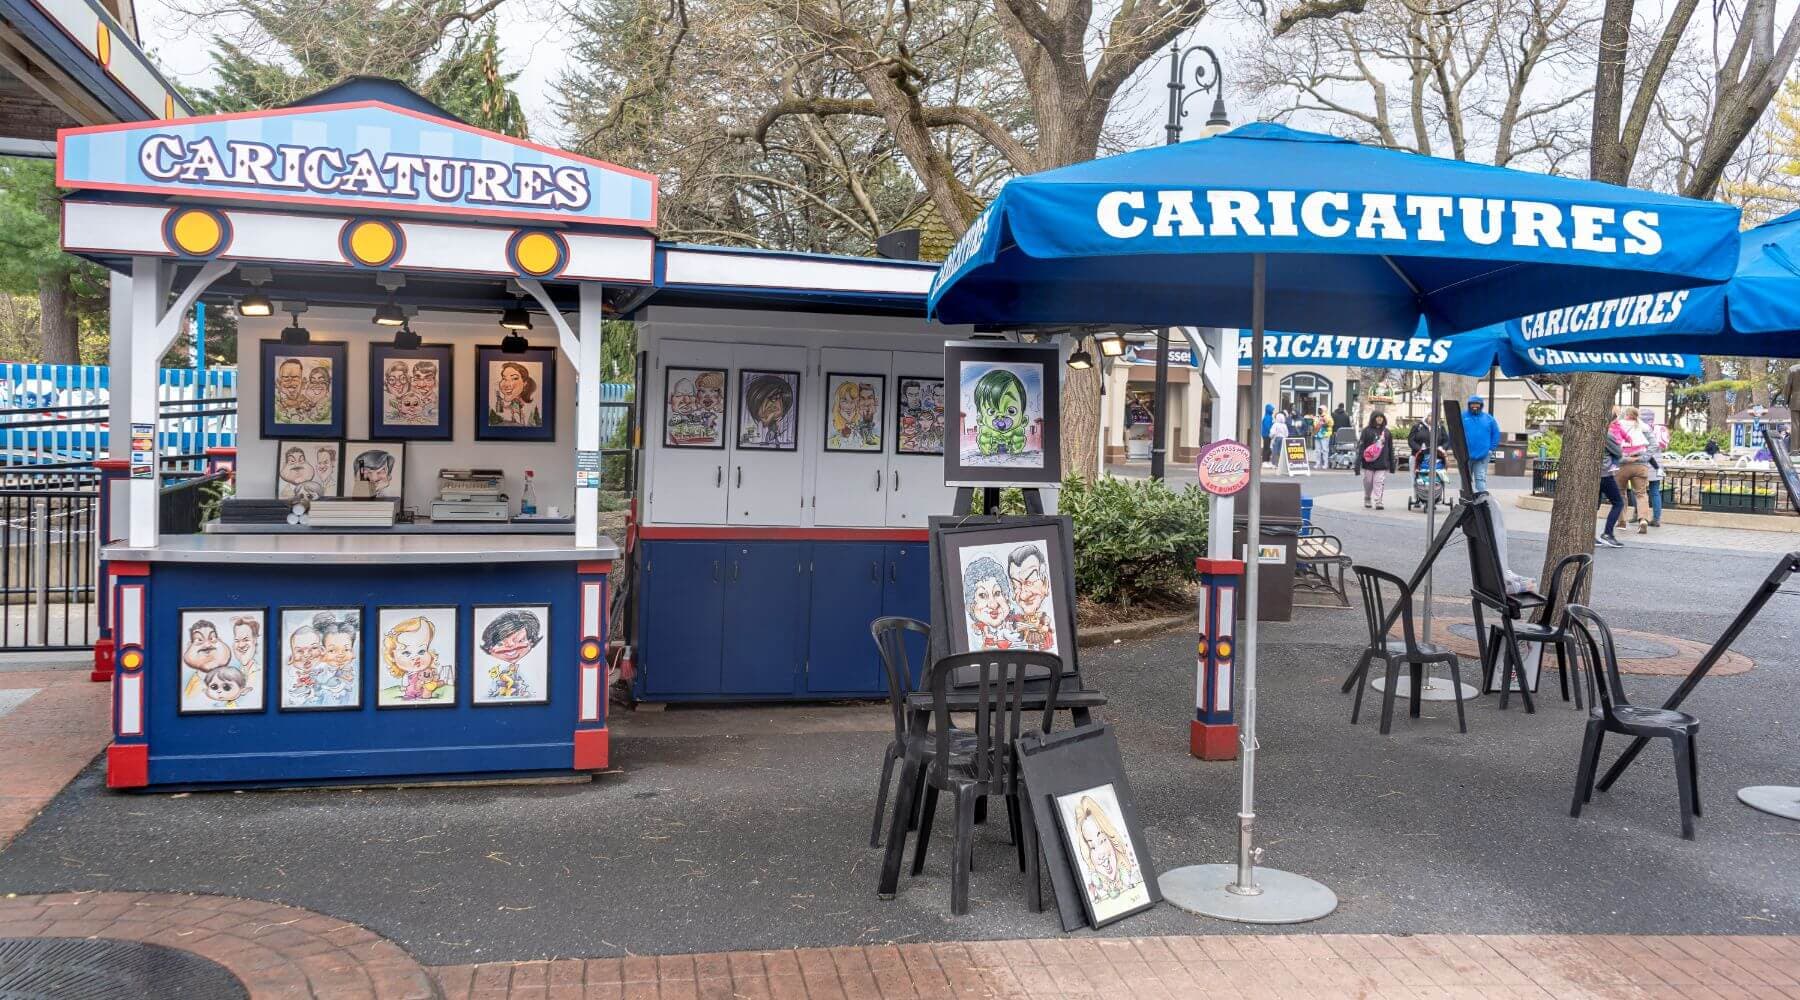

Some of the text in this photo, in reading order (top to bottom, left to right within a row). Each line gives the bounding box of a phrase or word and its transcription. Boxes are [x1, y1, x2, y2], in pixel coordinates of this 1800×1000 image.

[139, 134, 591, 210] CARICATURES
[1097, 190, 1662, 256] CARICATURES
[1520, 290, 1690, 342] CARICATURES
[1238, 334, 1453, 364] ARICATURES
